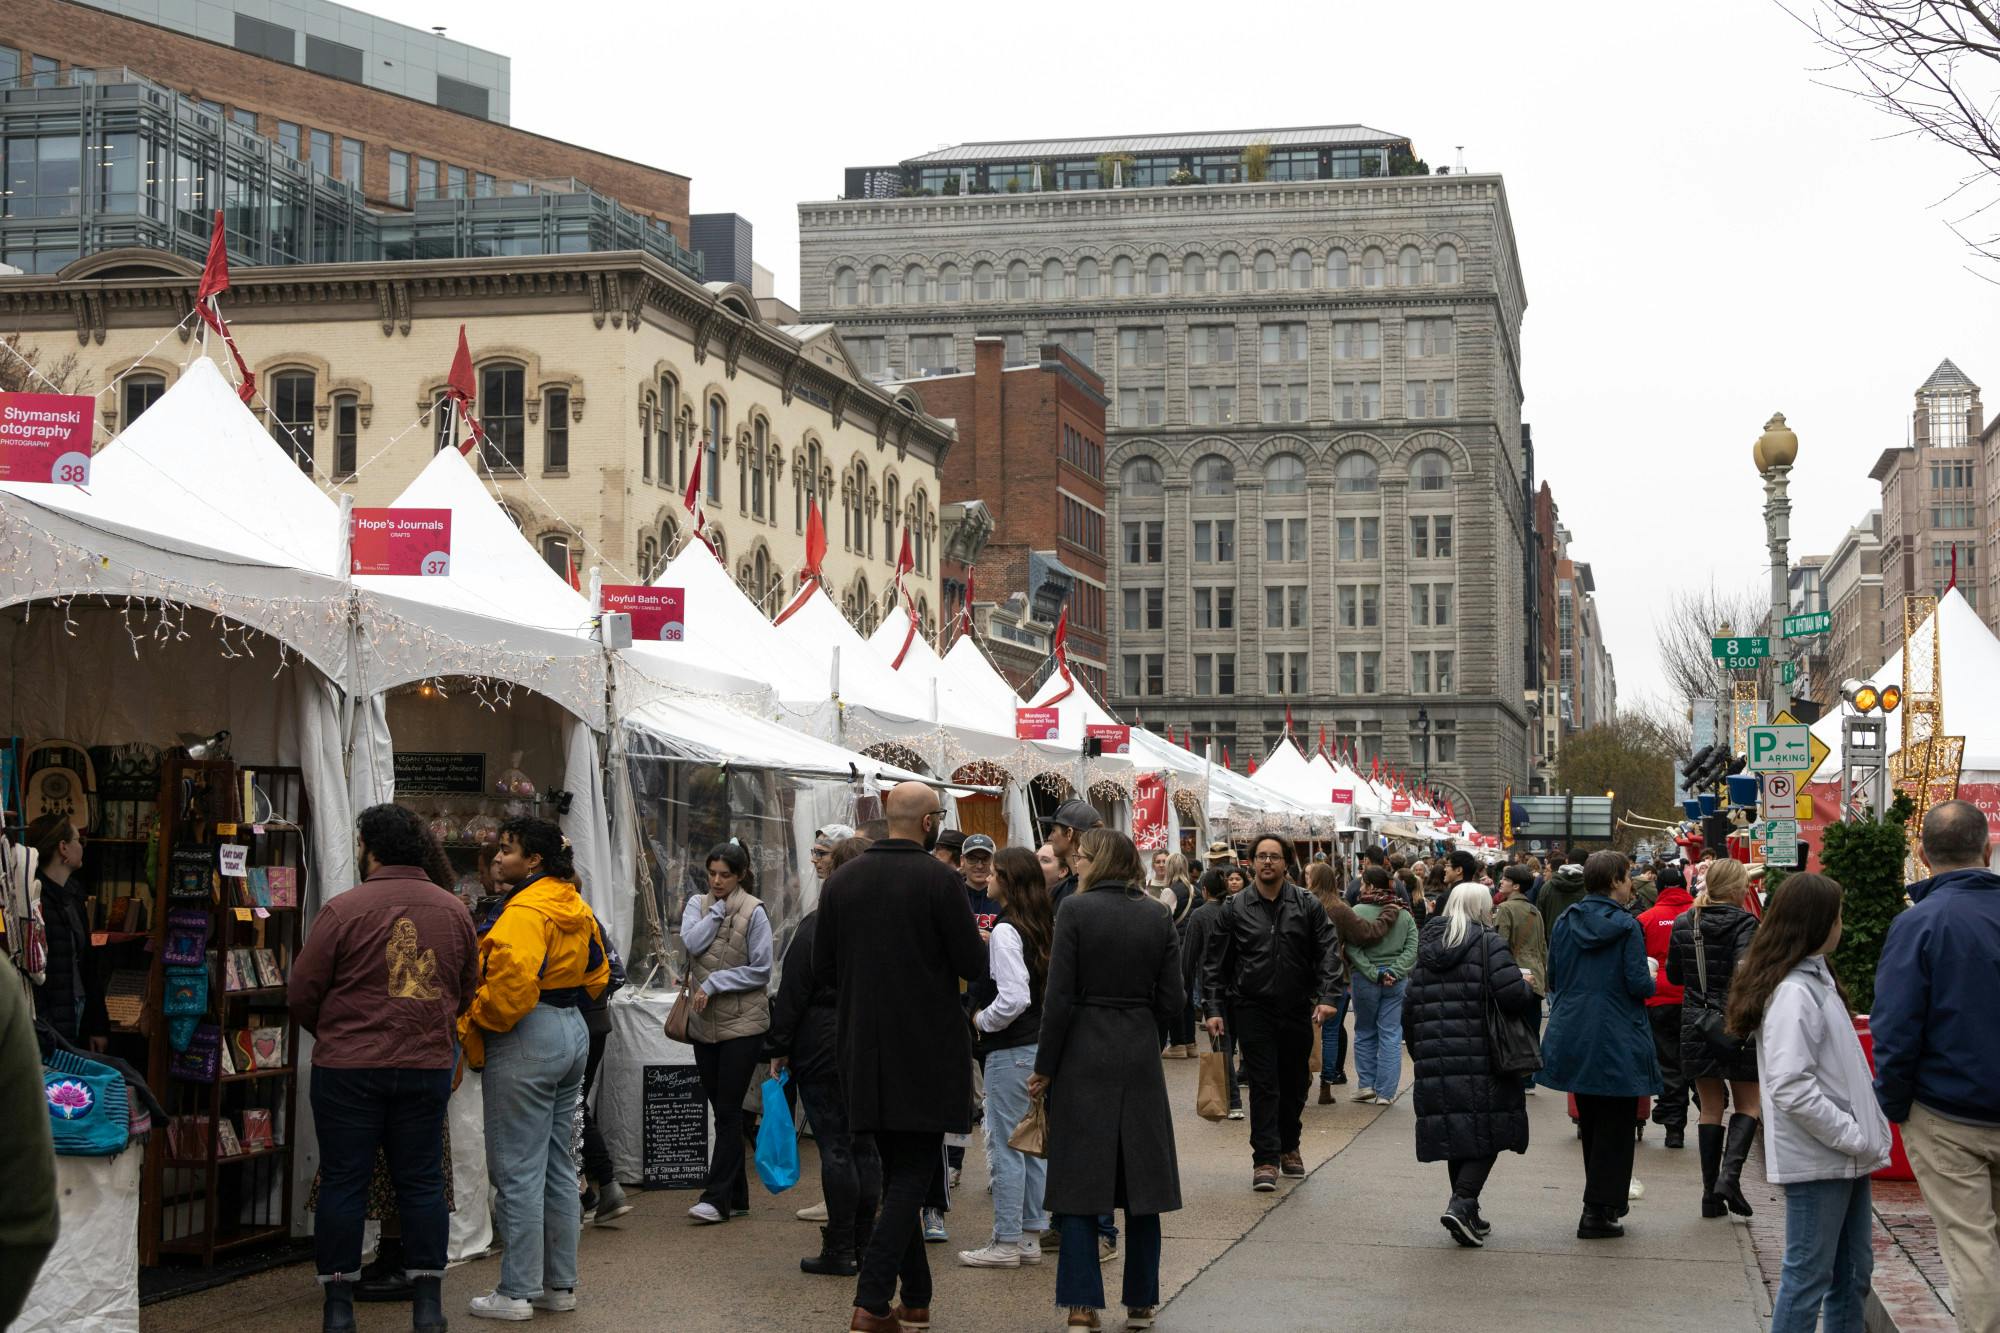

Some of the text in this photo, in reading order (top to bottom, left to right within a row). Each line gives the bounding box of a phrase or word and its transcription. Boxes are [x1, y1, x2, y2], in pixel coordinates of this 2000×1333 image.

[4, 406, 80, 424] Shymanski
[60, 464, 85, 482] 38
[358, 519, 444, 531] Hope's Journals
[427, 561, 446, 574] 37
[608, 594, 677, 605] Joyful Bath Co.
[666, 629, 681, 640] 36
[1726, 639, 1739, 655] 8
[1729, 656, 1757, 667] 500
[1975, 799, 1993, 809] for
